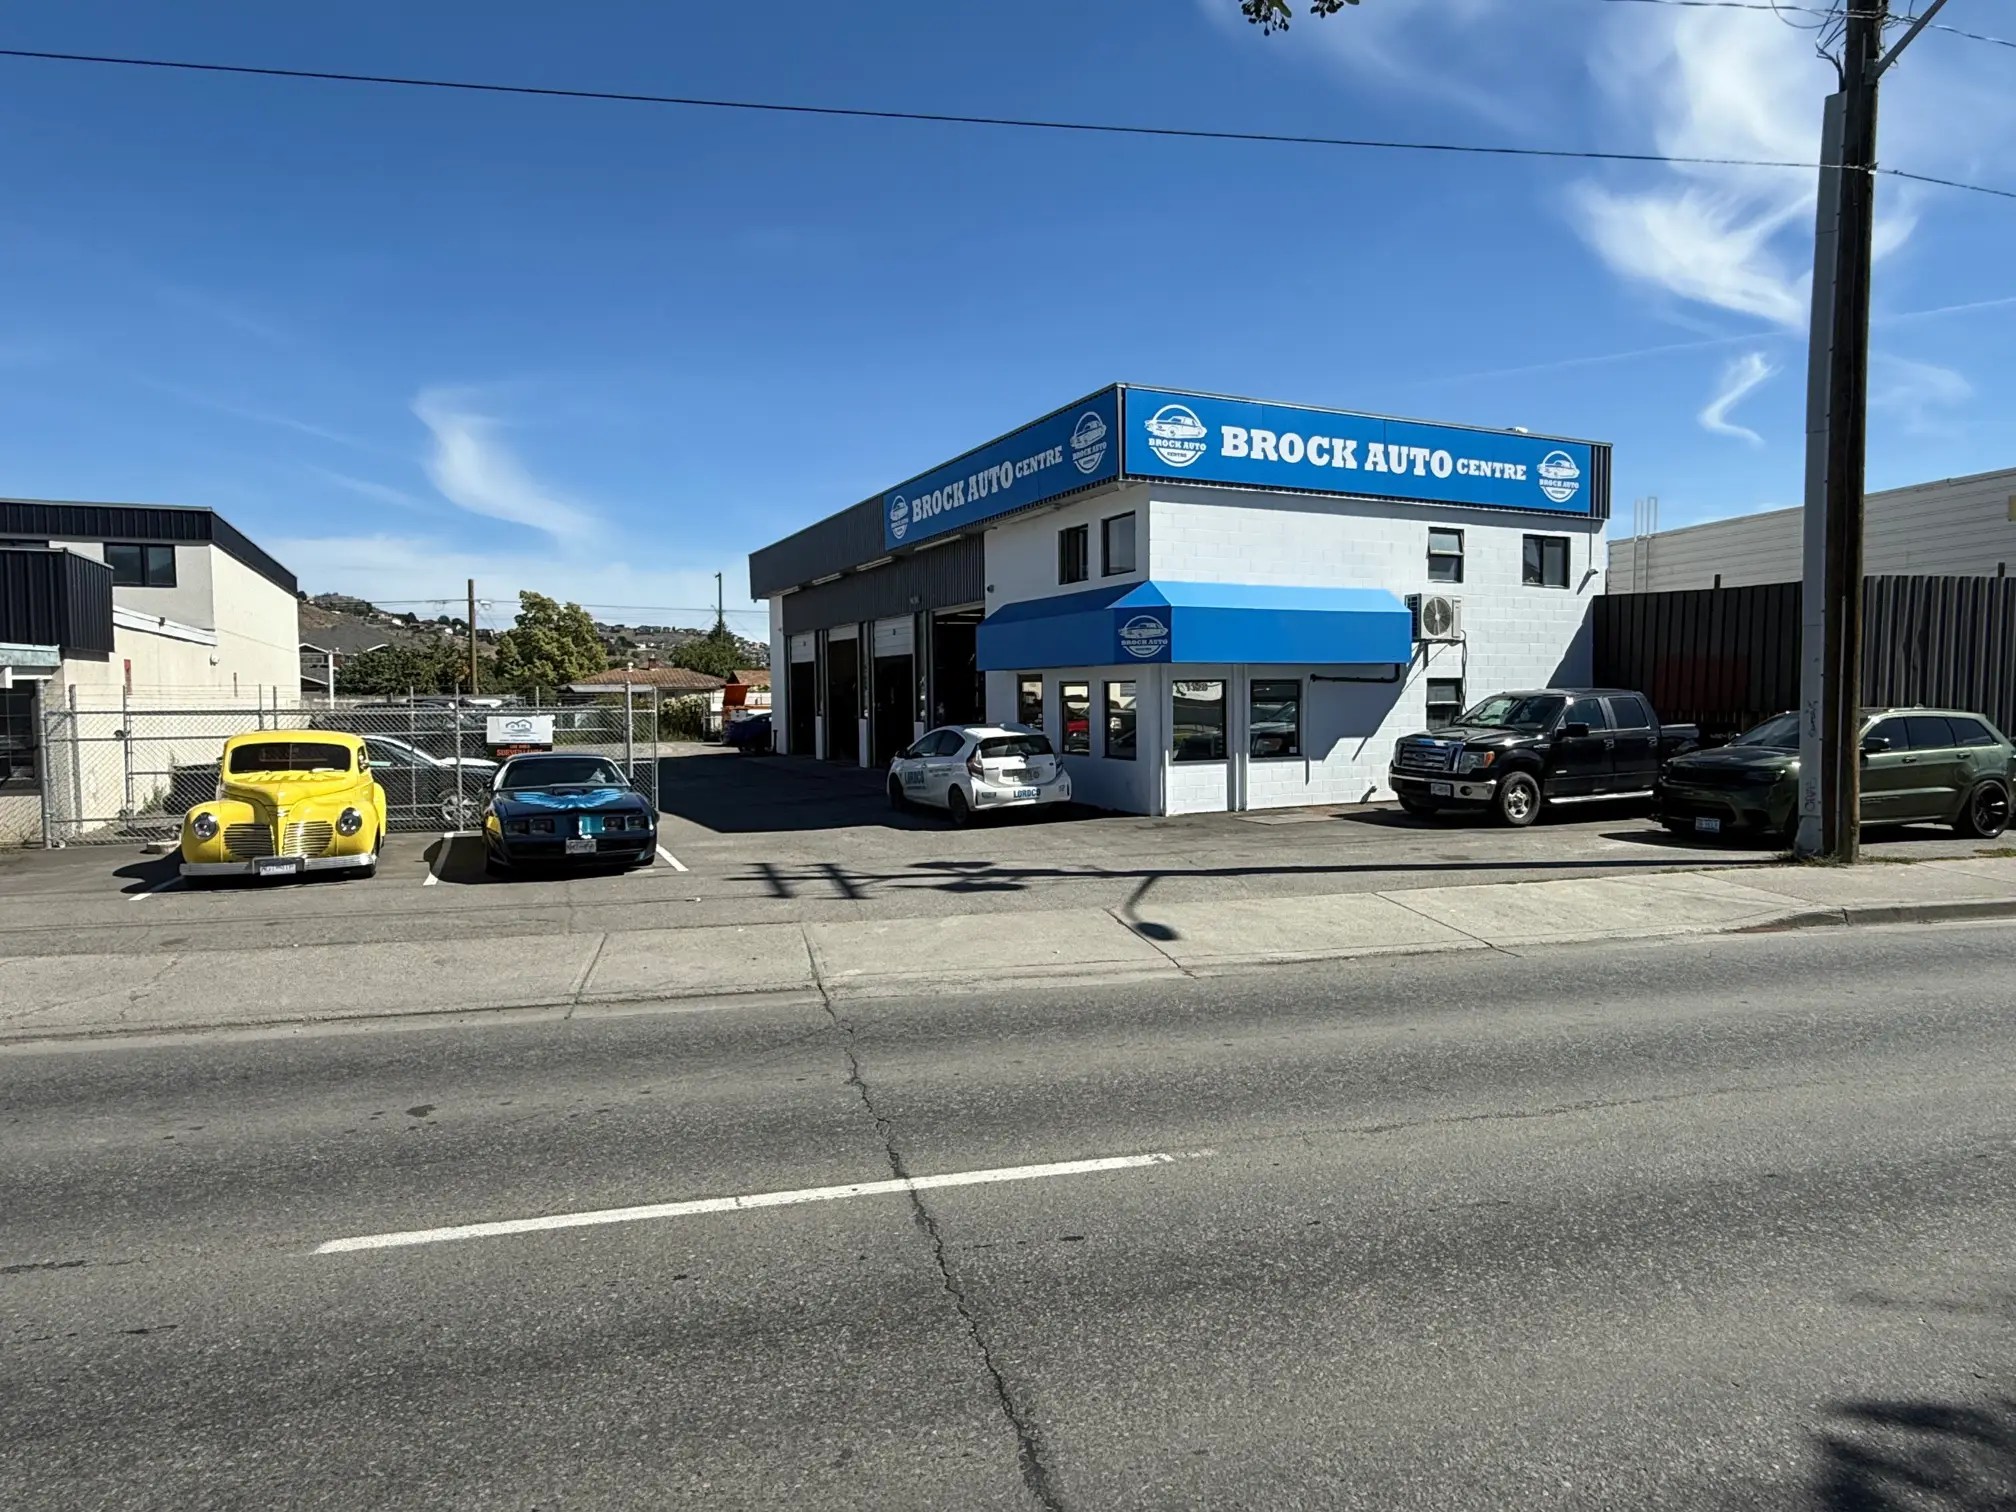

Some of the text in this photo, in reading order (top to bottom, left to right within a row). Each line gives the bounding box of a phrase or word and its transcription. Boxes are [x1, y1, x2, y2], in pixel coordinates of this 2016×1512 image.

[1148, 437, 1207, 451] BROCK AUTO
[1221, 425, 1527, 481] BROCK AUTO CENTRE
[912, 445, 1064, 523] BROCK AUTO CENTRE
